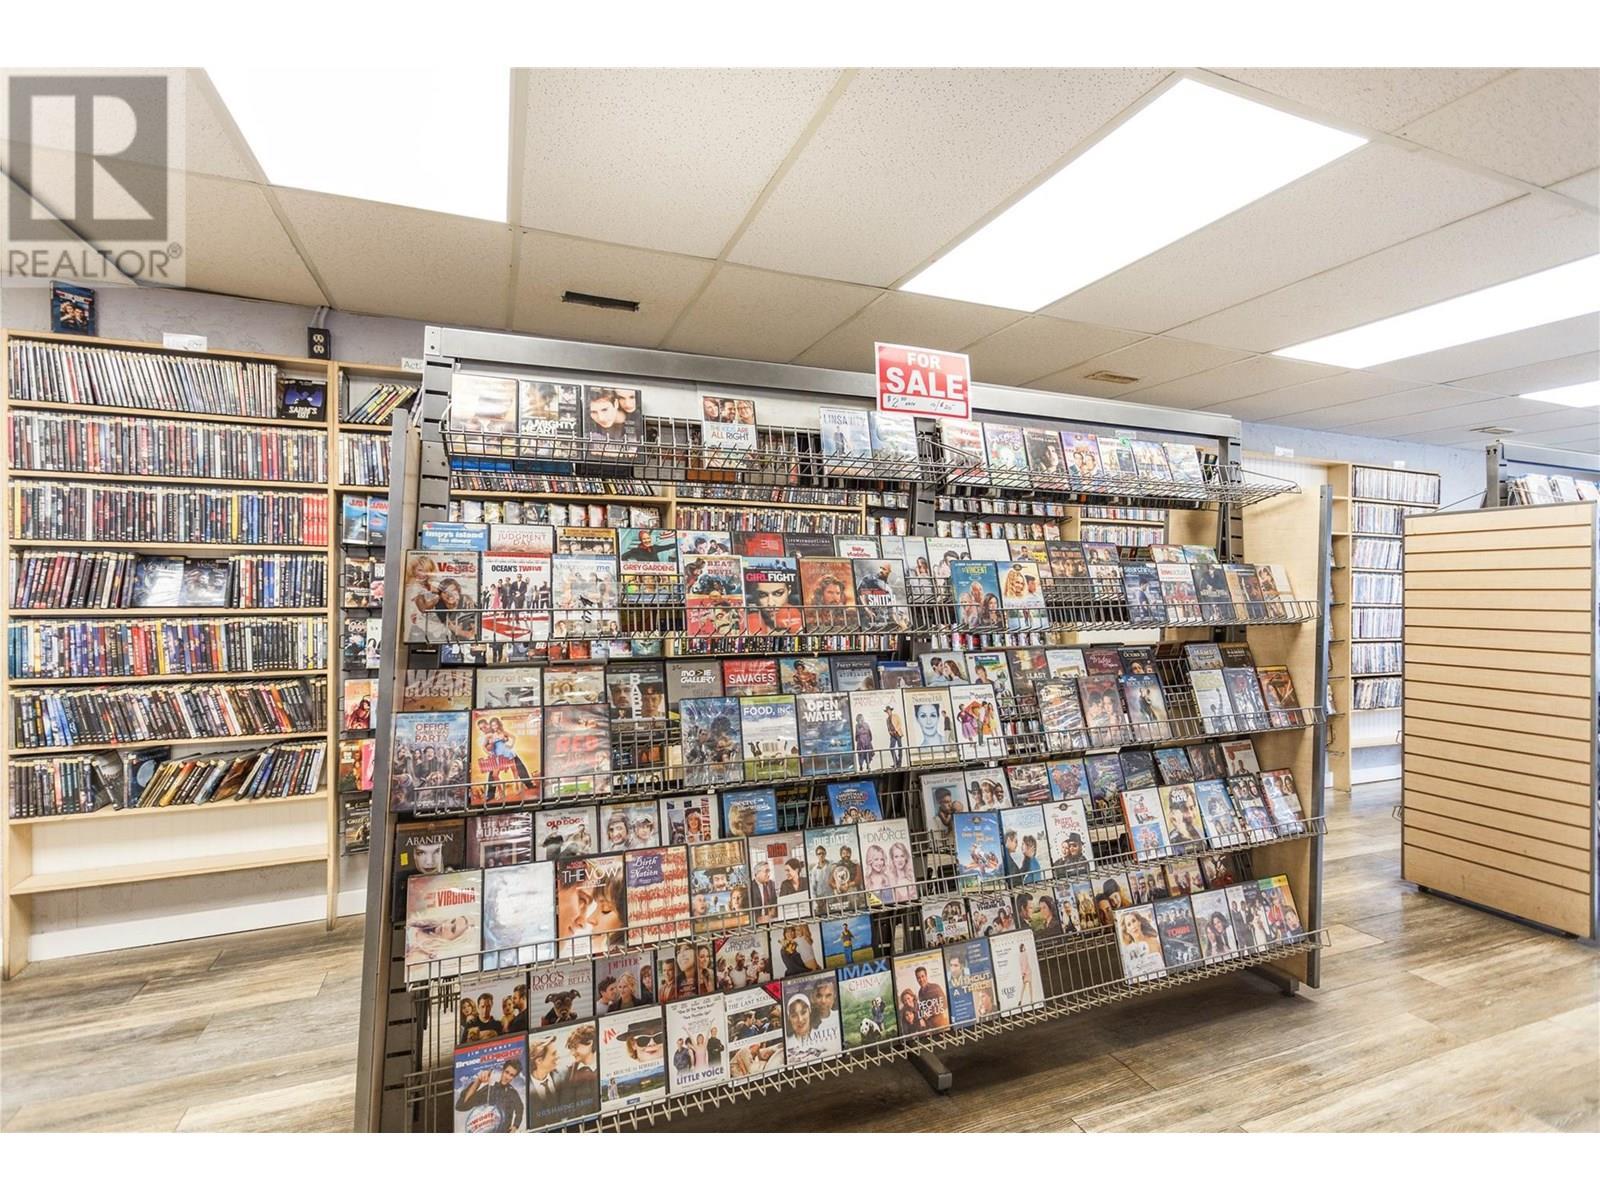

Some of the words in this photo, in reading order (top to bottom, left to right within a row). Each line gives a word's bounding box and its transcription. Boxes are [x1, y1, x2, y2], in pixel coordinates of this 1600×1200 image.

[906, 352, 941, 370] FOR
[886, 366, 964, 401] SALE
[288, 406, 318, 415] SALEM'S
[534, 420, 577, 430] MIGHTY
[711, 431, 724, 440] ALL
[725, 432, 750, 441] RIGHT
[498, 532, 546, 541] JUDGMENT
[437, 562, 476, 575] Vegas
[491, 564, 518, 573] OCEAN'S
[623, 564, 642, 572] GREY
[642, 564, 675, 572] GARDENS
[707, 560, 733, 568] BEAT
[868, 594, 896, 606] SNITCH
[681, 676, 716, 684] GALLERY
[729, 673, 774, 684] SAVAGES
[743, 706, 776, 716] FOOD,
[777, 706, 794, 714] INC.
[807, 700, 839, 711] OPEN
[803, 710, 843, 722] WATER
[416, 722, 449, 731] OFFICE
[415, 734, 449, 742] PARTY
[546, 820, 562, 828] OLD
[405, 834, 454, 847] ABANDON
[833, 834, 849, 844] DATE
[867, 829, 906, 842] DIVORCE
[632, 855, 658, 867] Birth
[562, 869, 584, 883] THE
[584, 865, 618, 881] VOW
[631, 870, 659, 879] Nation
[1167, 926, 1191, 937] TOWN
[838, 959, 888, 981] IMAX
[532, 971, 564, 986] DOG'S
[568, 976, 592, 986] BELLA
[847, 976, 882, 992] CHINA
[918, 998, 944, 1009] PEOPLE
[918, 1009, 934, 1019] LIKE
[934, 1007, 945, 1015] US
[800, 1027, 838, 1048] FAMILY
[456, 1058, 481, 1069] Bruce
[676, 1072, 700, 1086] LITTLE
[701, 1066, 725, 1080] VOICE
